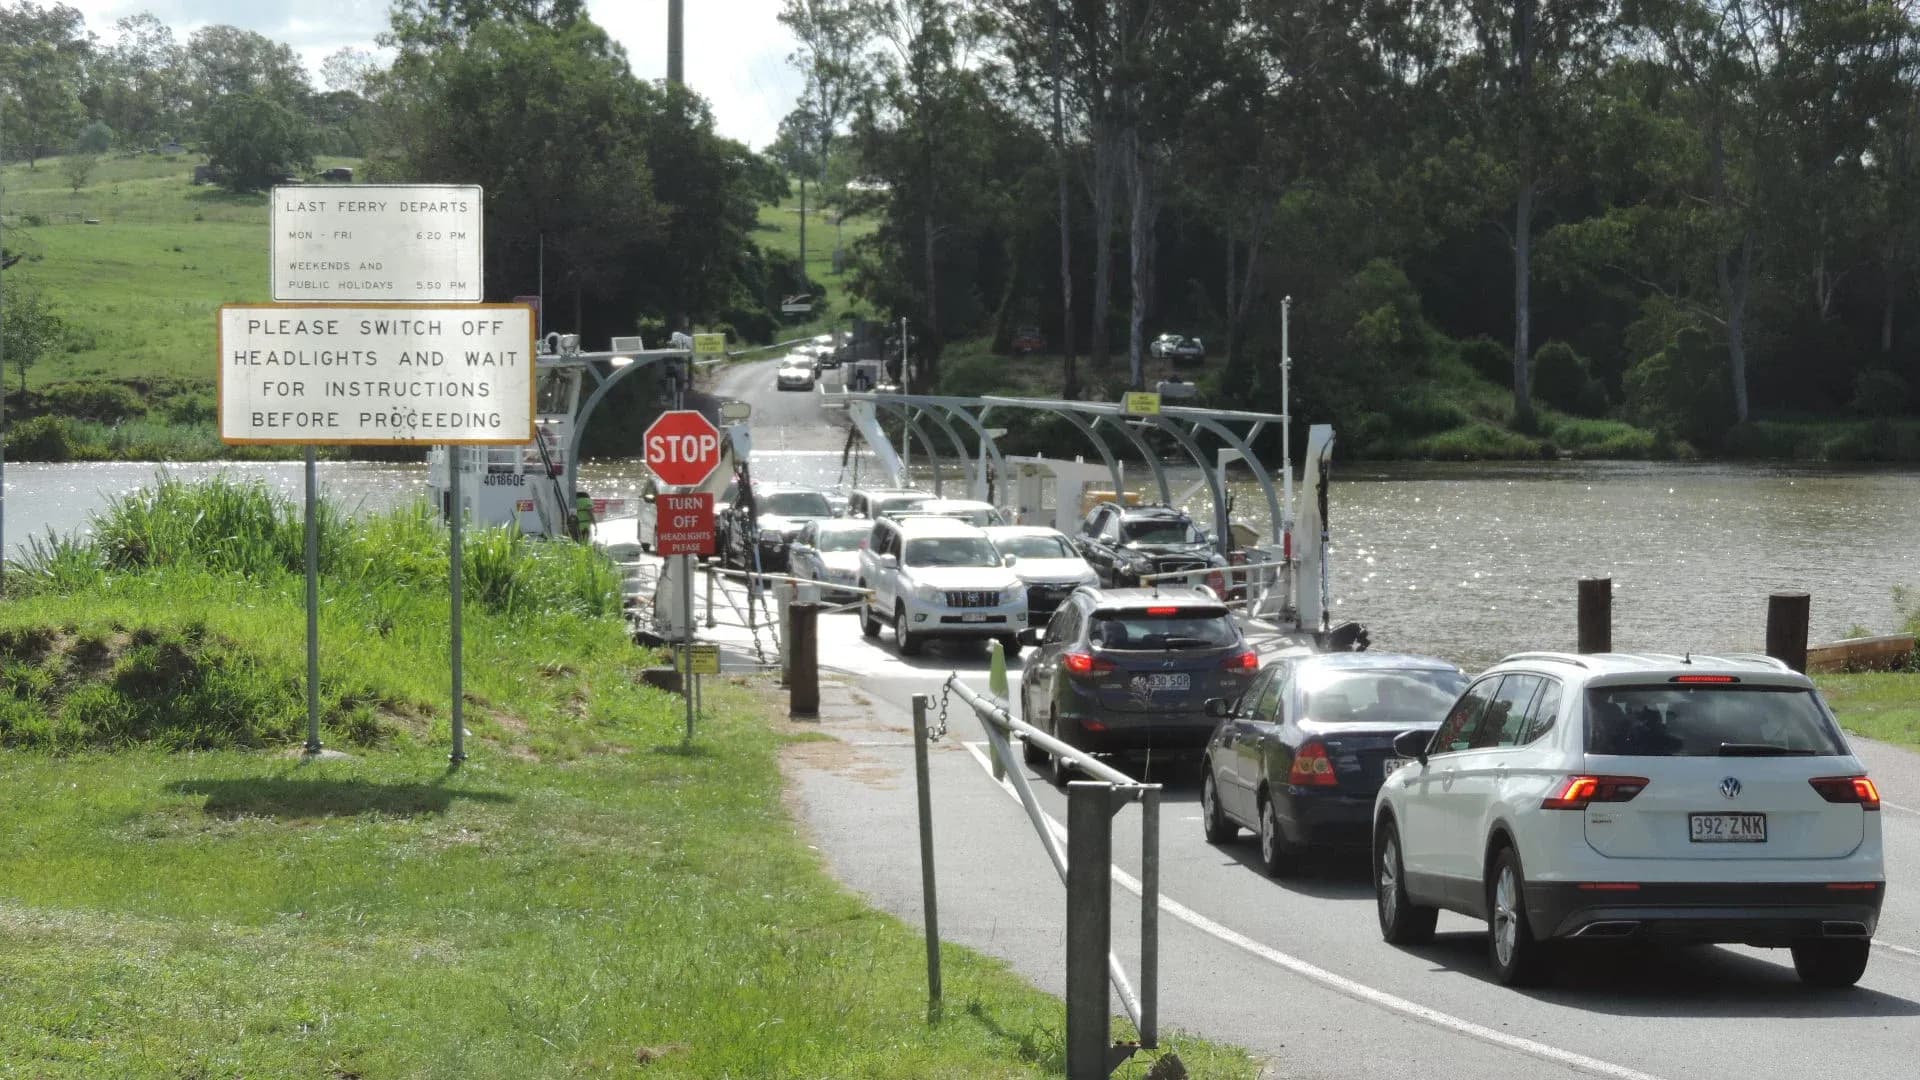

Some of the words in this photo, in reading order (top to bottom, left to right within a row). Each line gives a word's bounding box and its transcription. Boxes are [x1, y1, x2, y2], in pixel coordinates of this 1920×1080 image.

[286, 201, 326, 213] LAST
[338, 201, 387, 213] FERRY
[400, 201, 468, 213] DEPARTS
[289, 231, 313, 240] MON
[333, 231, 353, 240] FRI
[416, 231, 442, 240] 6.20
[449, 231, 466, 240] PM
[289, 261, 351, 271] WEEKENDS
[359, 261, 383, 271] AND
[288, 280, 330, 289] PUBLIC
[338, 280, 393, 290] HOLIDAYS
[416, 280, 442, 290] 5.50
[449, 281, 466, 290] PM
[248, 319, 339, 336] PLEASE
[359, 319, 442, 336] SWITCH
[461, 320, 504, 336] OFF
[234, 350, 378, 366] HEADLIGHTS
[398, 351, 444, 367] AND
[465, 351, 518, 367] WAIT
[263, 381, 305, 397] FOR
[325, 381, 490, 398] INSTRUCTIONS
[252, 411, 339, 428] BEFORE
[359, 411, 501, 429] PROCEEDING
[649, 434, 717, 464] STOP
[667, 497, 703, 510] TURN
[673, 514, 699, 528] OFF
[660, 532, 711, 541] HEADLIGHTS
[672, 543, 701, 552] PLEASE
[1694, 817, 1723, 835] 392
[1729, 816, 1763, 835] ZNK
